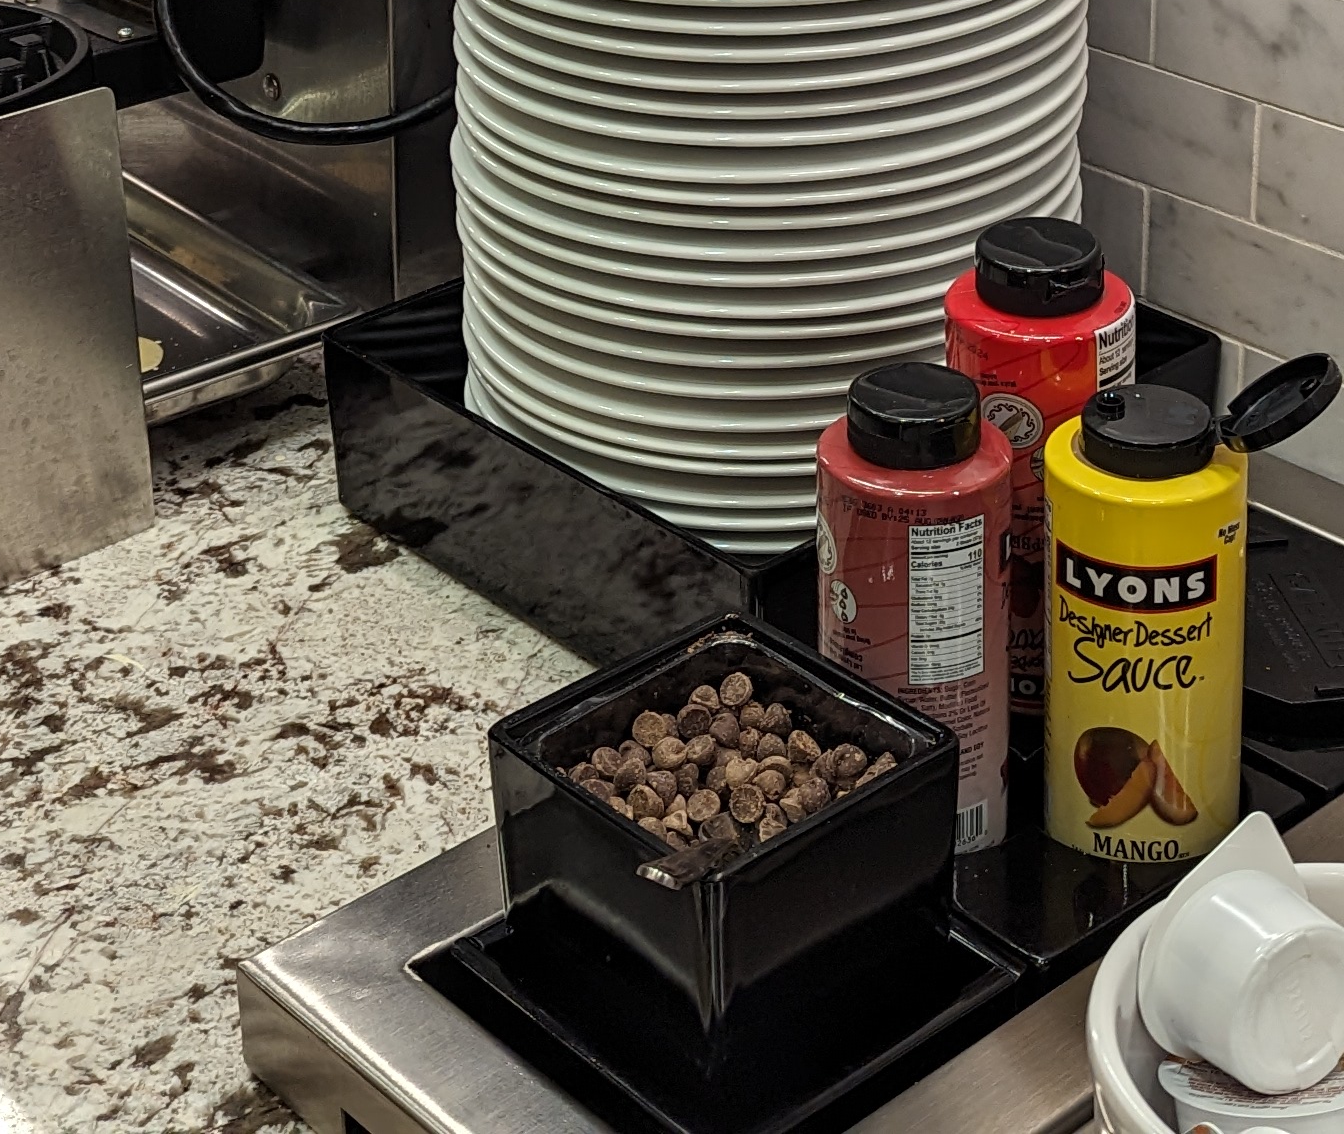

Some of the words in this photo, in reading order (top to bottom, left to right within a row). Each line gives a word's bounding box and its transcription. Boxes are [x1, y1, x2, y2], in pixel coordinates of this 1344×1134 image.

[911, 526, 956, 537] Nutrition
[958, 519, 983, 533] Facts
[911, 560, 943, 569] Calories
[968, 548, 983, 561] 110
[1066, 557, 1206, 604] LYONS
[1059, 595, 1133, 649] Designer
[1134, 612, 1213, 647] Dessert
[1068, 637, 1197, 694] Sauce
[1092, 832, 1179, 861] MANGO
